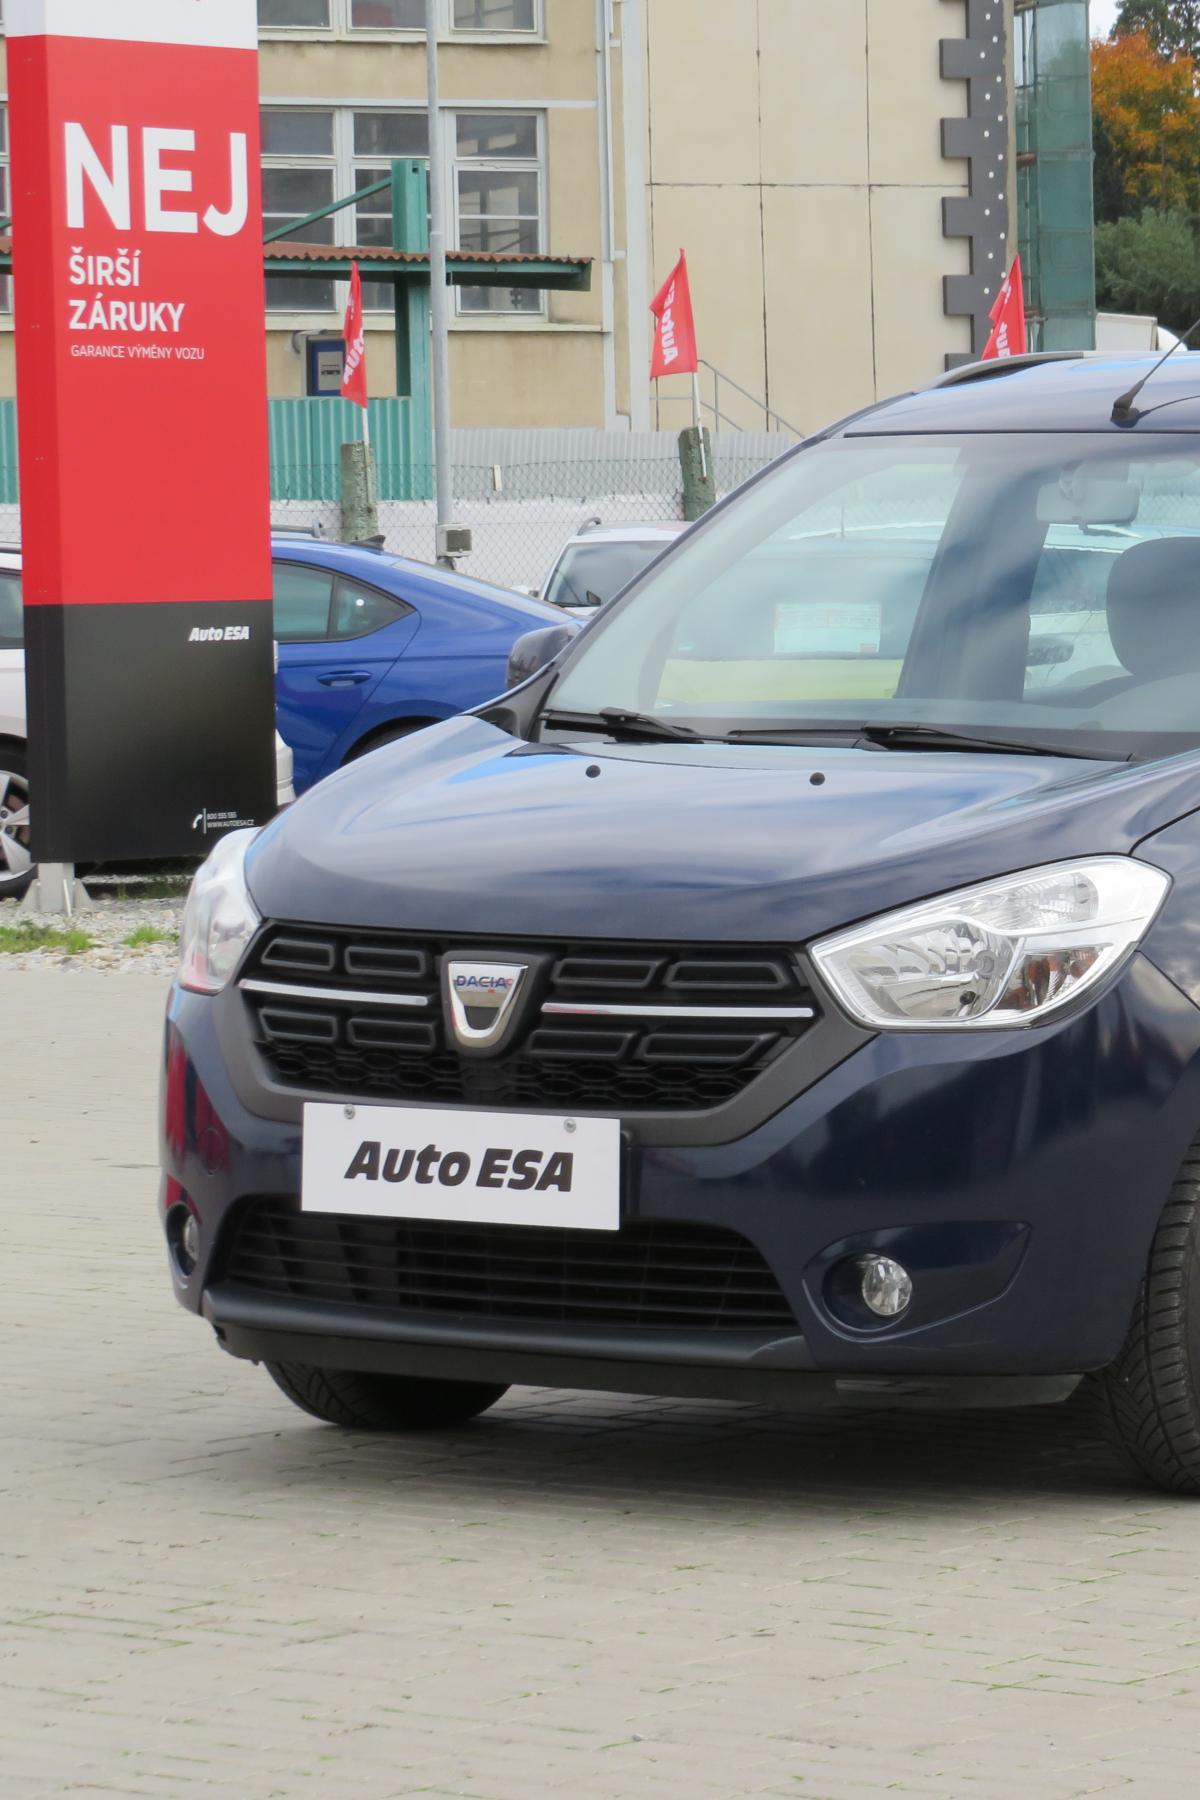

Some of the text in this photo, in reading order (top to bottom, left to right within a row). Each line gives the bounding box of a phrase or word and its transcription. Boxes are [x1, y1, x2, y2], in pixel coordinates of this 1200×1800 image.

[64, 122, 249, 236] NEJ
[68, 246, 141, 287] ŠIRŠÍ
[68, 292, 186, 332] ZÁRUKY
[70, 343, 205, 360] GARANCE VÝMĚNY VOZU
[188, 626, 250, 642] Auto ESA
[456, 975, 506, 989] DACIA
[344, 1141, 574, 1193] Auto ESA
